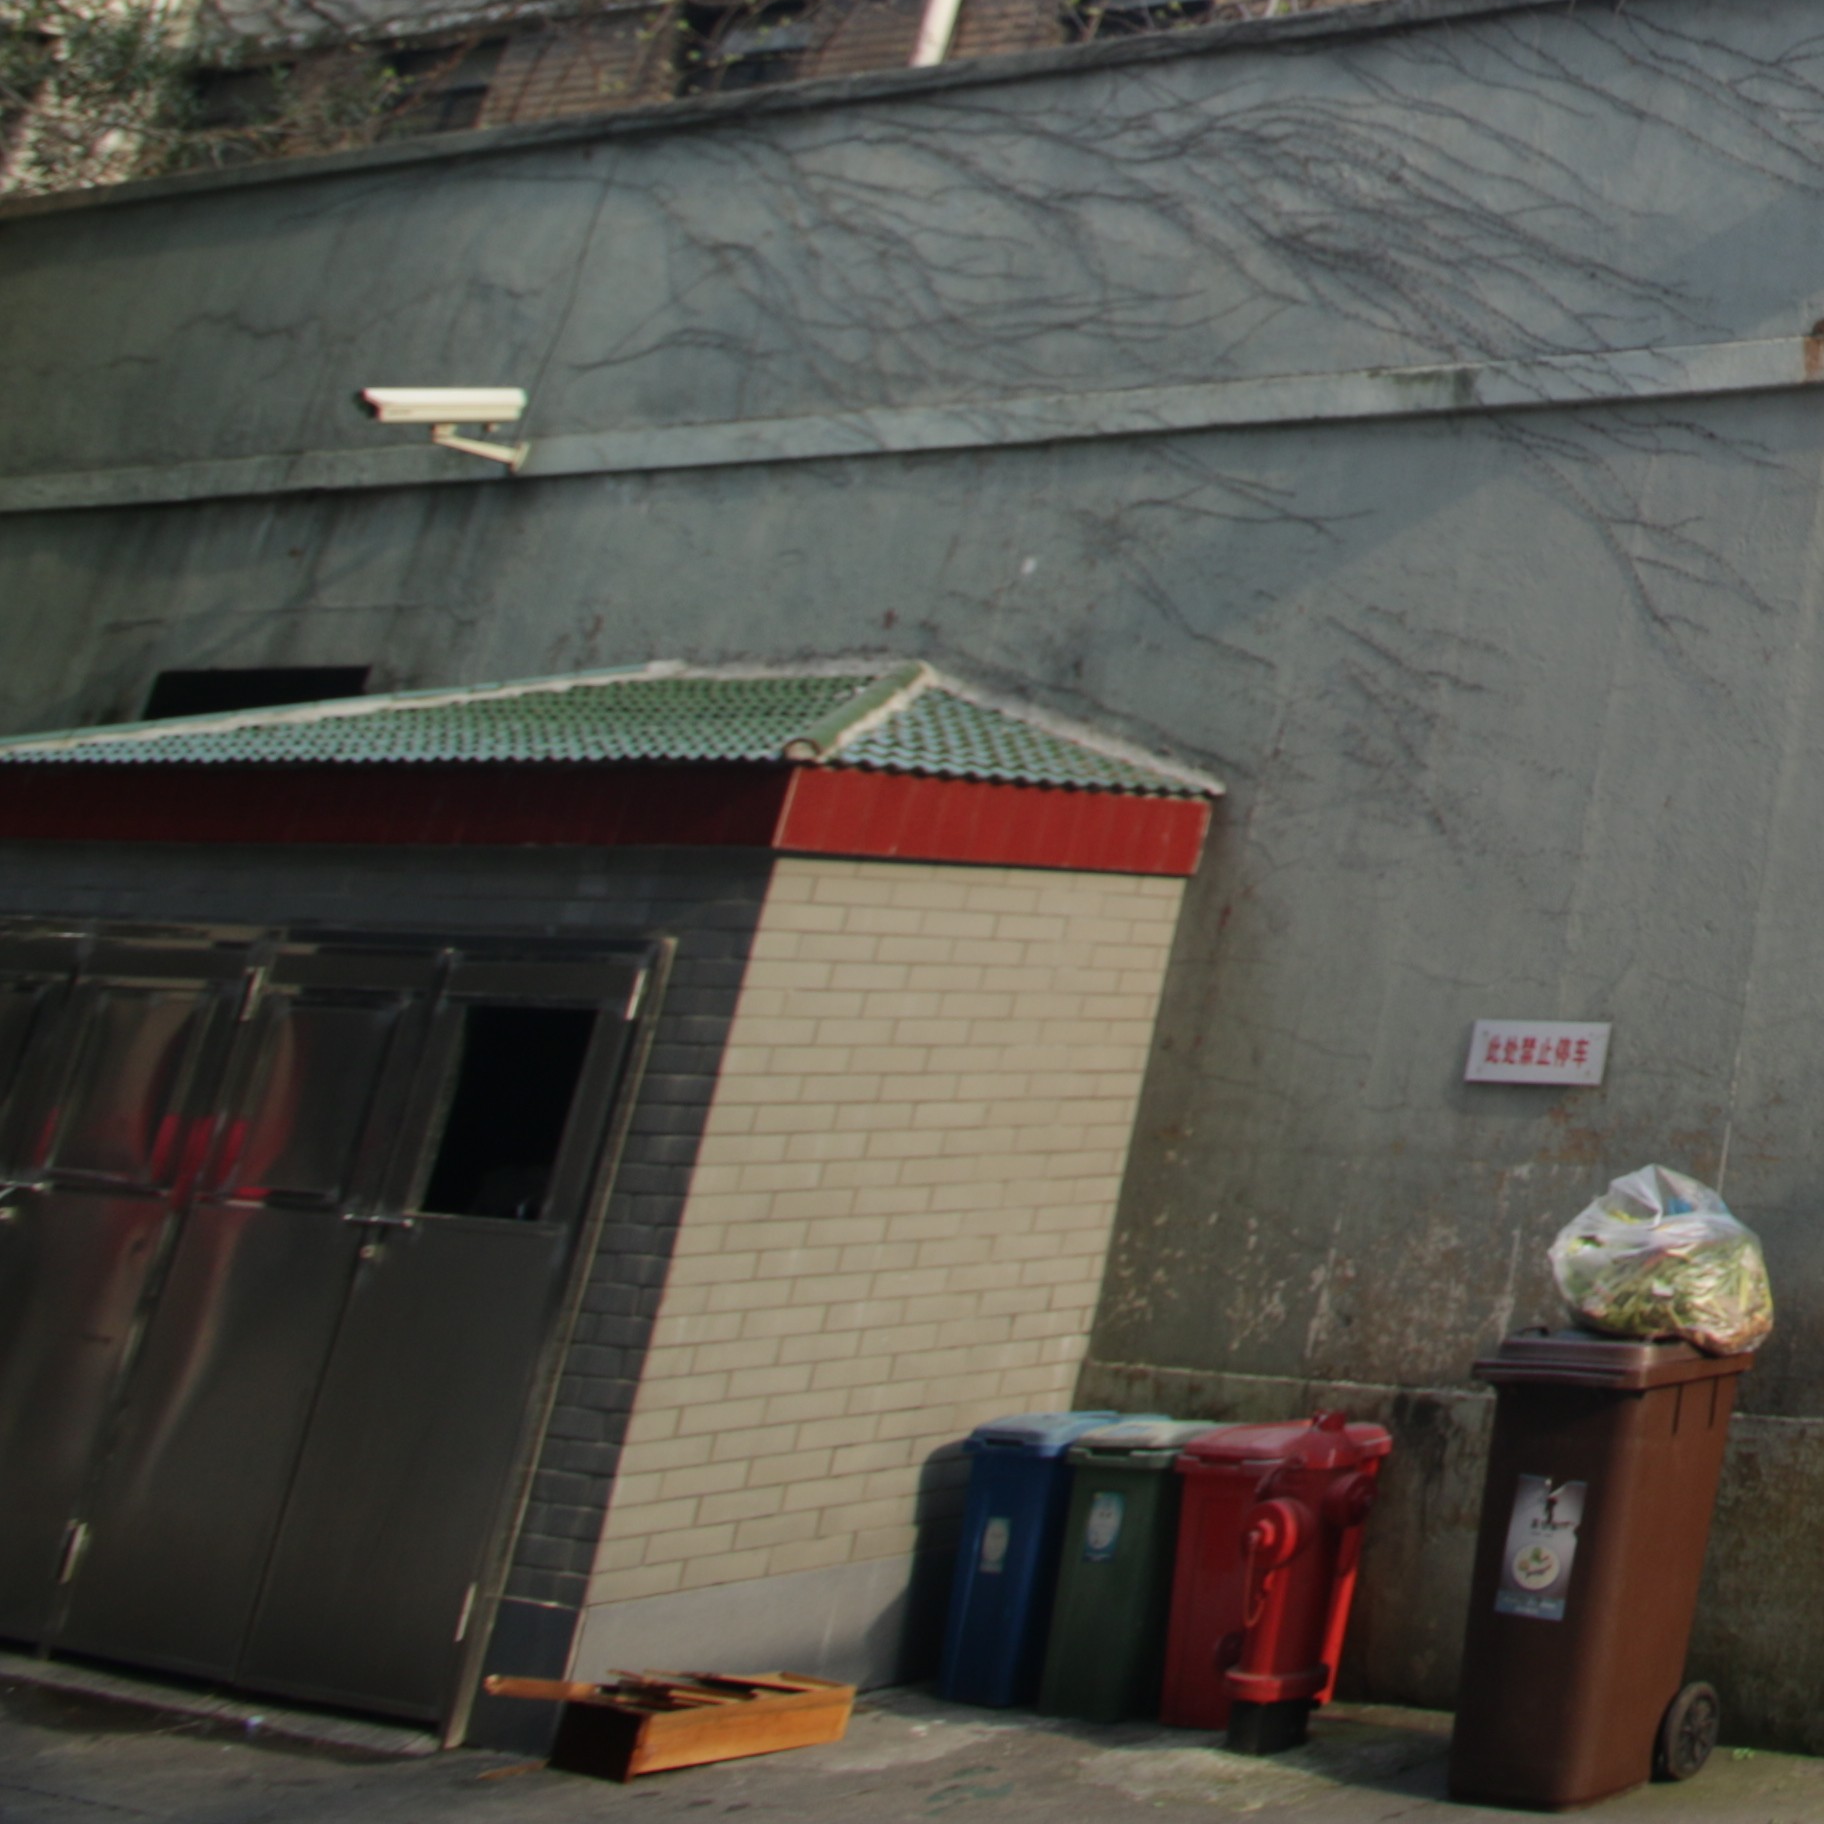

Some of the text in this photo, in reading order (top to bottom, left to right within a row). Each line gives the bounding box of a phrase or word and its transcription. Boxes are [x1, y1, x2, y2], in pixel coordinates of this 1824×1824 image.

[1485, 1036, 1589, 1067] 此处禁止停车
